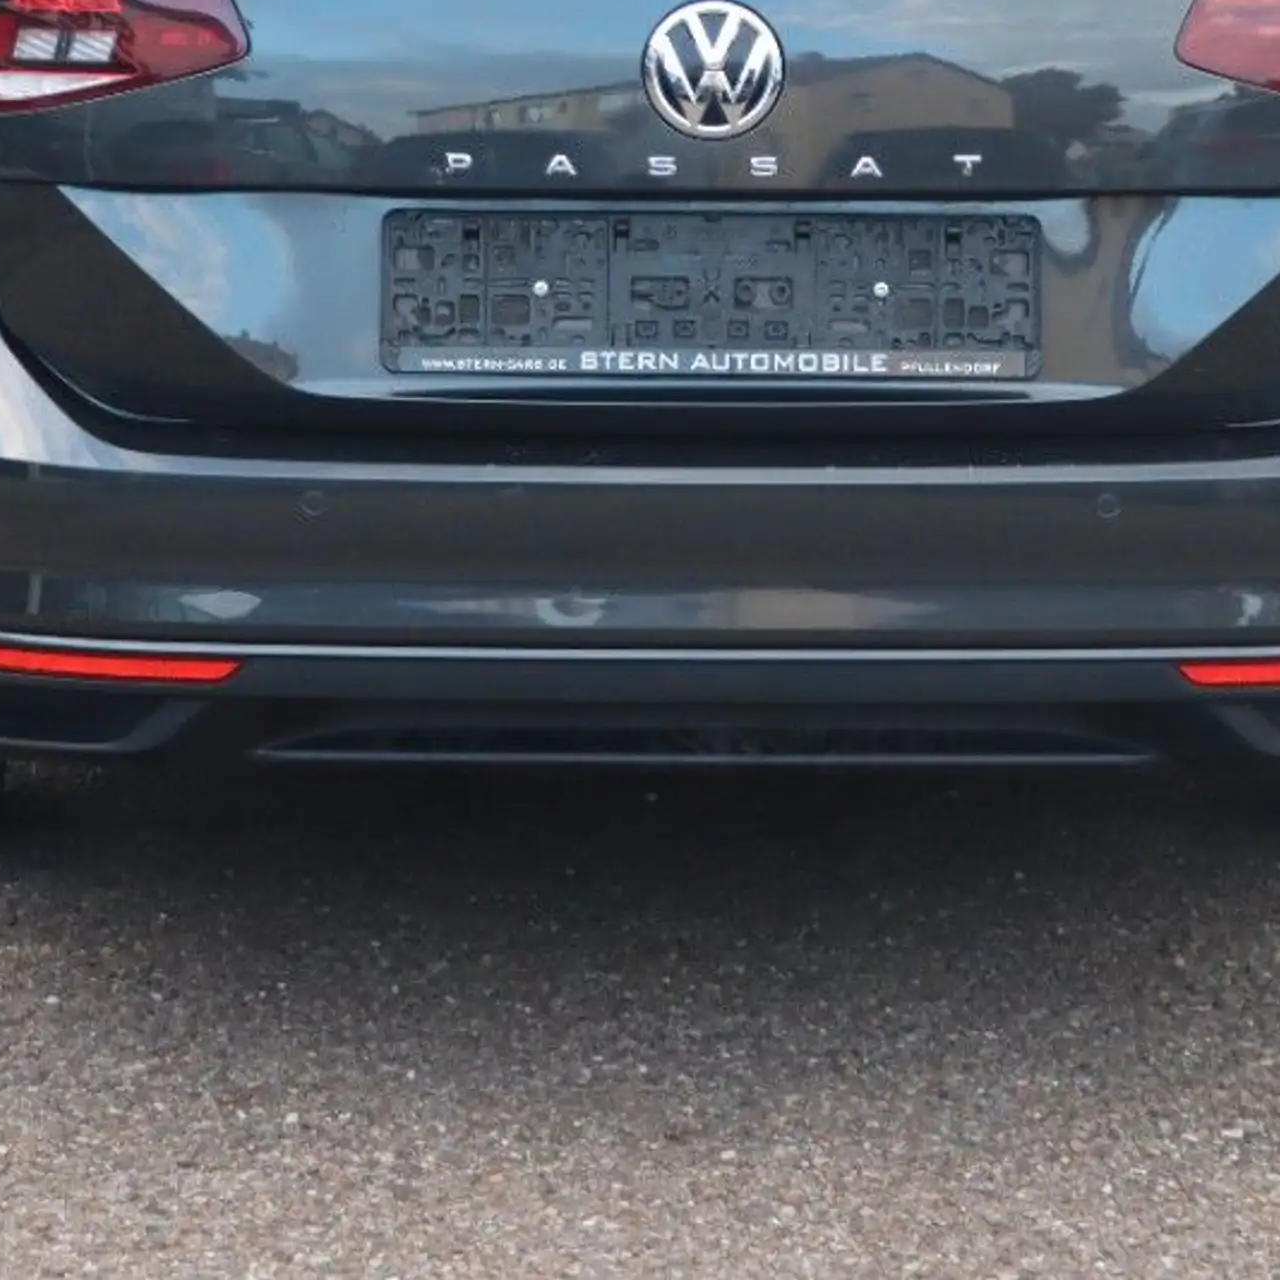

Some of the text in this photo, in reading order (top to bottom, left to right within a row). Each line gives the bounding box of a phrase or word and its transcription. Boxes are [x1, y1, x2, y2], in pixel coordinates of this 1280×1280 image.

[445, 151, 983, 178] PASSAT
[580, 350, 679, 371] STERN
[689, 351, 888, 372] AUTOMOBILE
